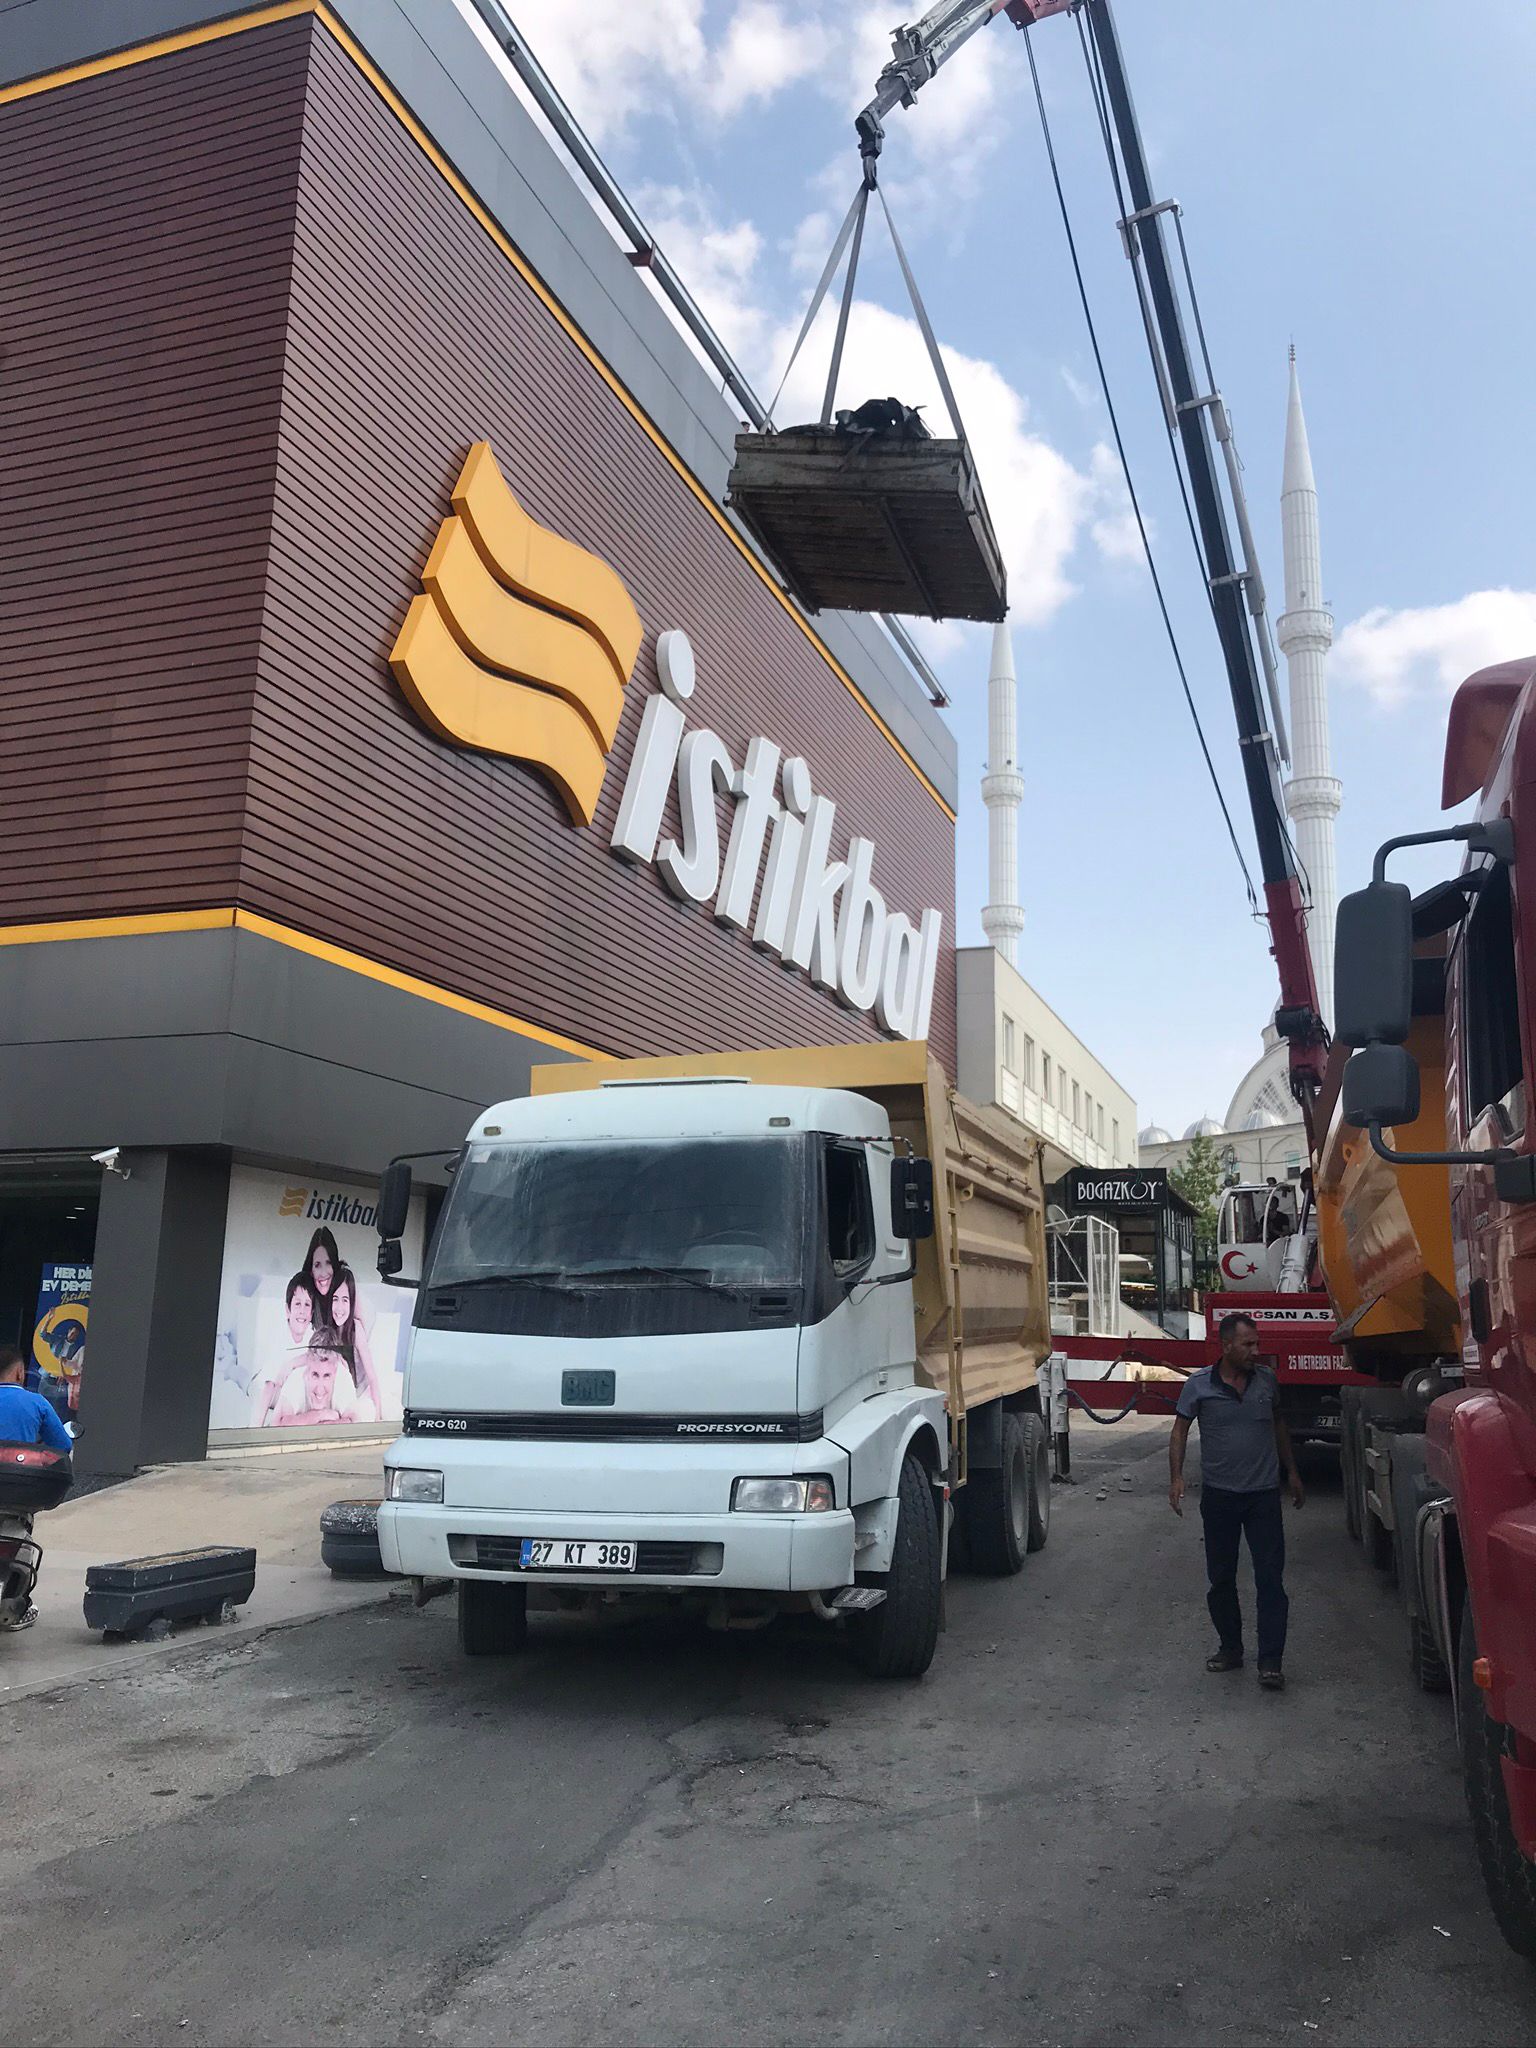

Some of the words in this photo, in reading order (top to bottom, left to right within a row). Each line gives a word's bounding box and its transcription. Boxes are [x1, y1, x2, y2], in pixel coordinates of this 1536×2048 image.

[610, 629, 942, 1041] istikbal
[53, 1266, 76, 1279] HER
[42, 1280, 59, 1291] EV
[1288, 1355, 1297, 1370] 25
[1298, 1355, 1331, 1370] METREDEN
[417, 1419, 446, 1429] PRO
[447, 1419, 467, 1430] 620
[677, 1423, 784, 1433] PROFESYONEL
[531, 1542, 554, 1563] 27
[564, 1543, 587, 1564] KT
[598, 1544, 631, 1565] 389
